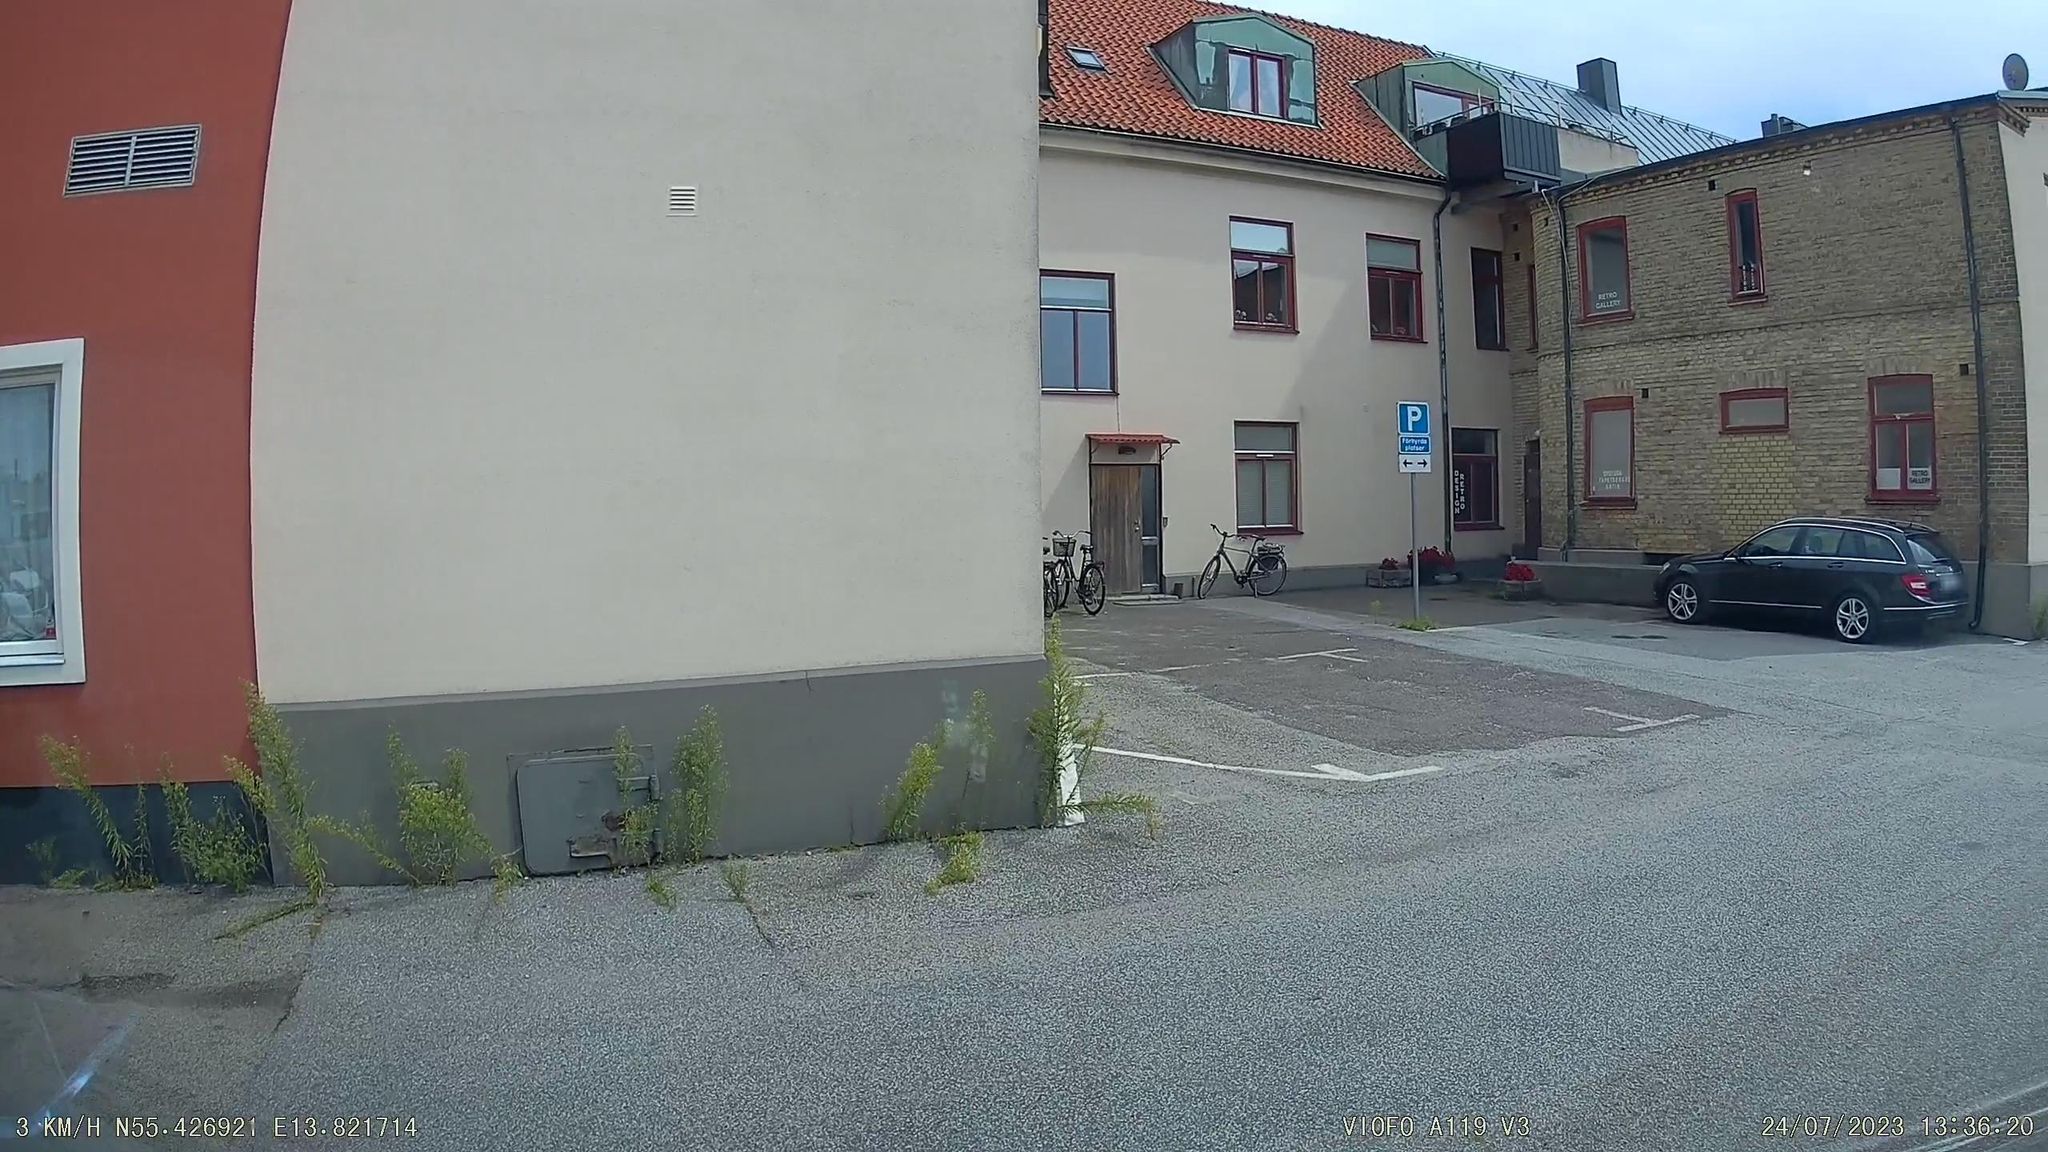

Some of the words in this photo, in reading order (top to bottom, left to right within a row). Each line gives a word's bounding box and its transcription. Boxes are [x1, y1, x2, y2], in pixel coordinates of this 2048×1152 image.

[1598, 291, 1617, 300] RETRO
[1595, 300, 1620, 309] GALLERY
[1407, 406, 1422, 431] P
